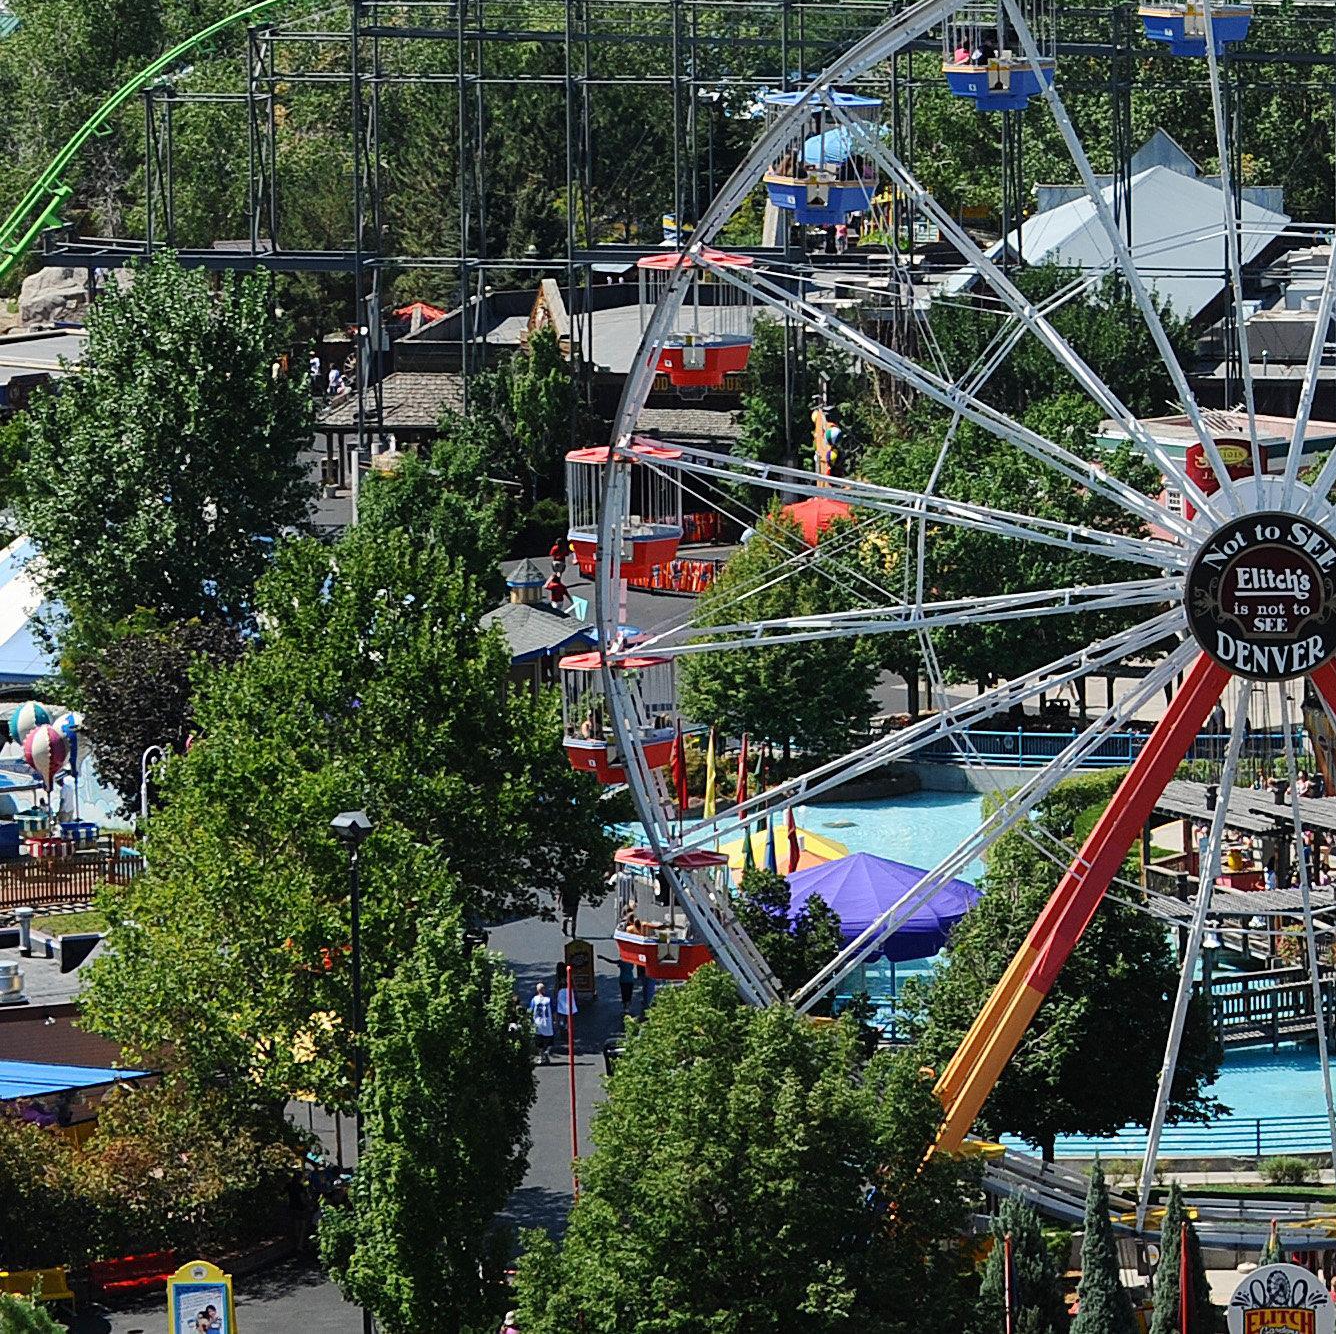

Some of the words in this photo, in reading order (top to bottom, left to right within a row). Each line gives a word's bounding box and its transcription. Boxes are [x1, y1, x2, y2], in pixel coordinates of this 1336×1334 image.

[1201, 530, 1248, 571] Not
[1254, 523, 1281, 541] to
[1234, 567, 1311, 599] Elitch's
[1233, 601, 1249, 615] is
[1256, 601, 1286, 616] not
[1292, 603, 1311, 616] to
[1253, 617, 1288, 633] SEE
[1216, 629, 1325, 675] DENVER
[1246, 1310, 1313, 1334] ELITCH
